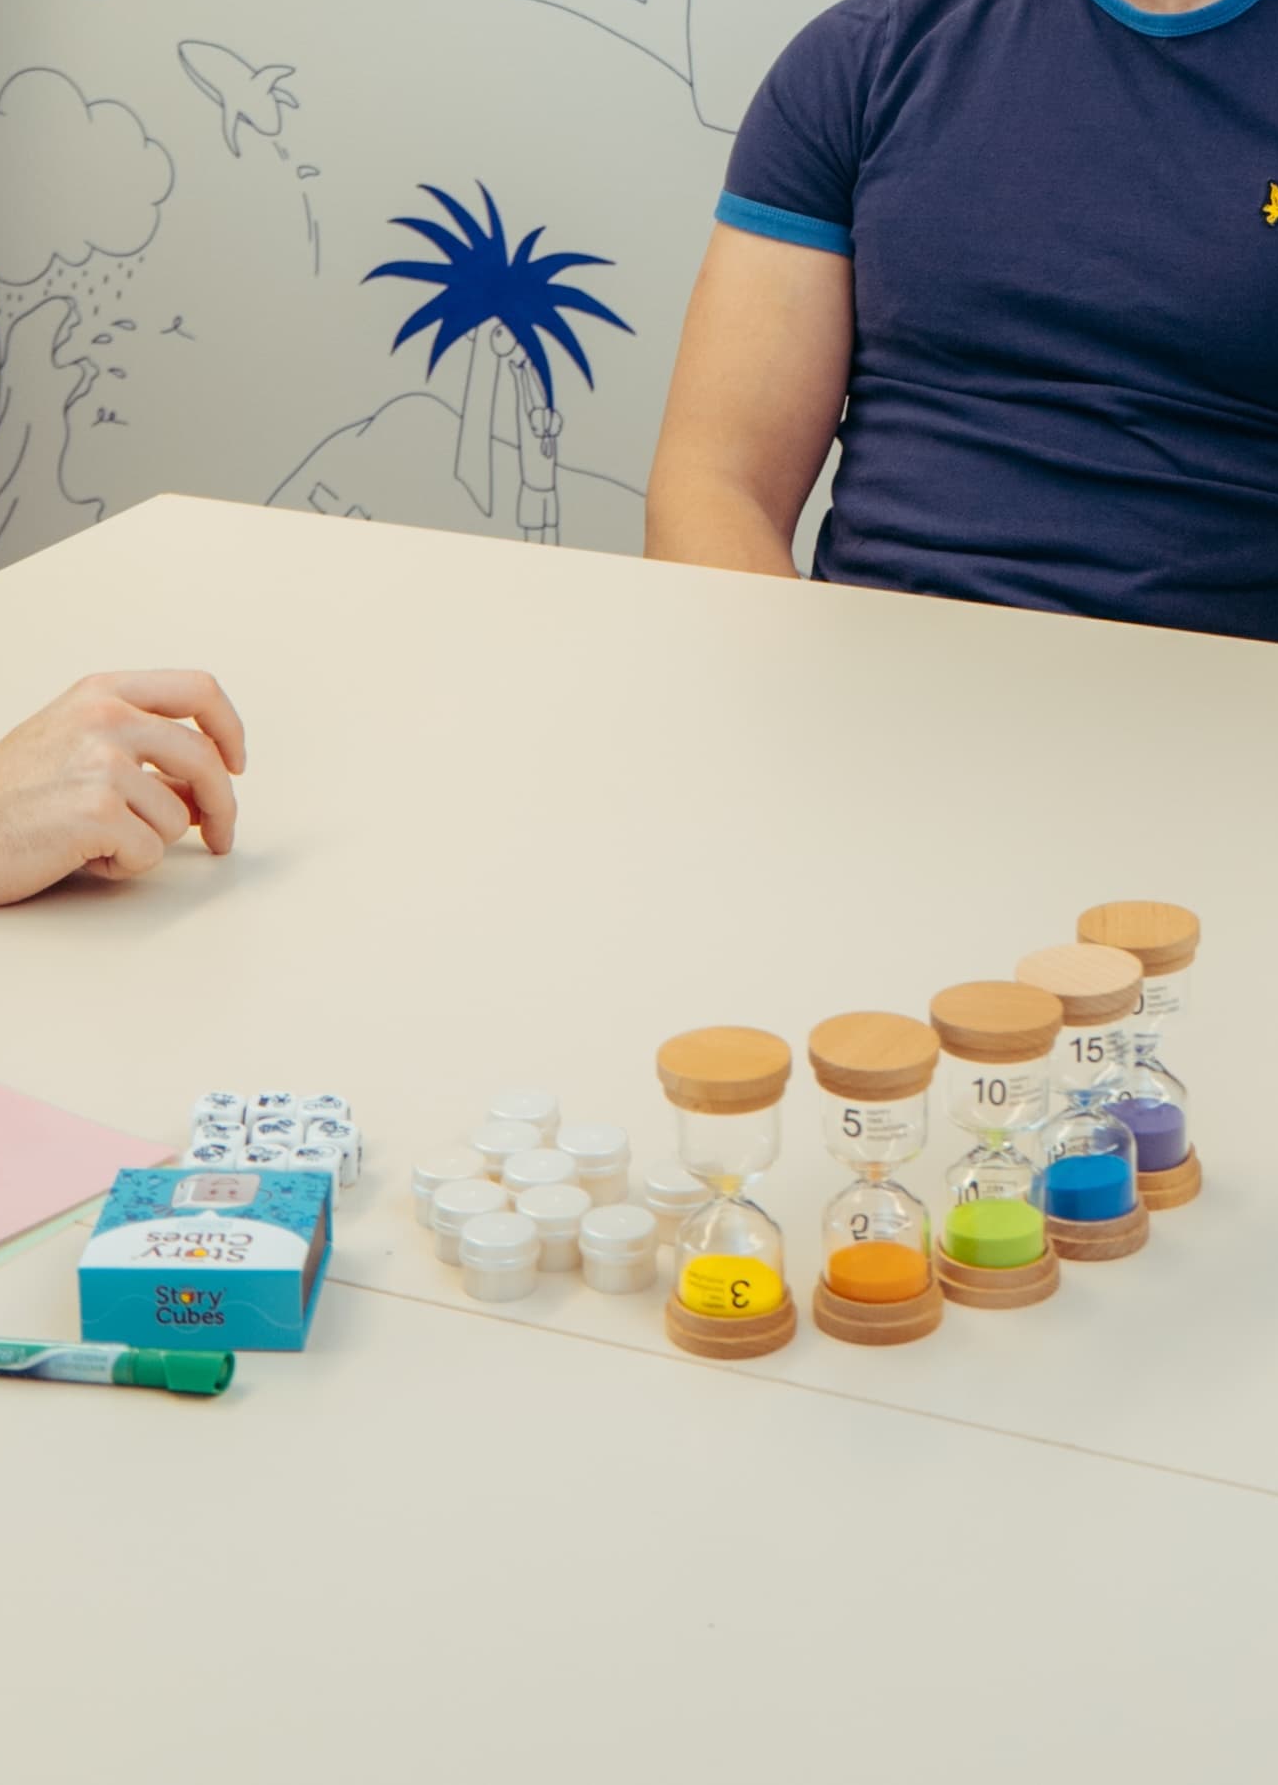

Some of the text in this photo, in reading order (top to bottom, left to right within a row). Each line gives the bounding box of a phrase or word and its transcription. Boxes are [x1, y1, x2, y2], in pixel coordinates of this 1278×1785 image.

[1068, 1036, 1104, 1063] 15
[972, 1078, 1007, 1106] 10
[842, 1108, 862, 1138] 5
[146, 1231, 254, 1247] Cubes
[140, 1243, 247, 1263] Story
[155, 1285, 223, 1309] Story
[730, 1279, 751, 1309] 3
[155, 1306, 226, 1326] Cubes
